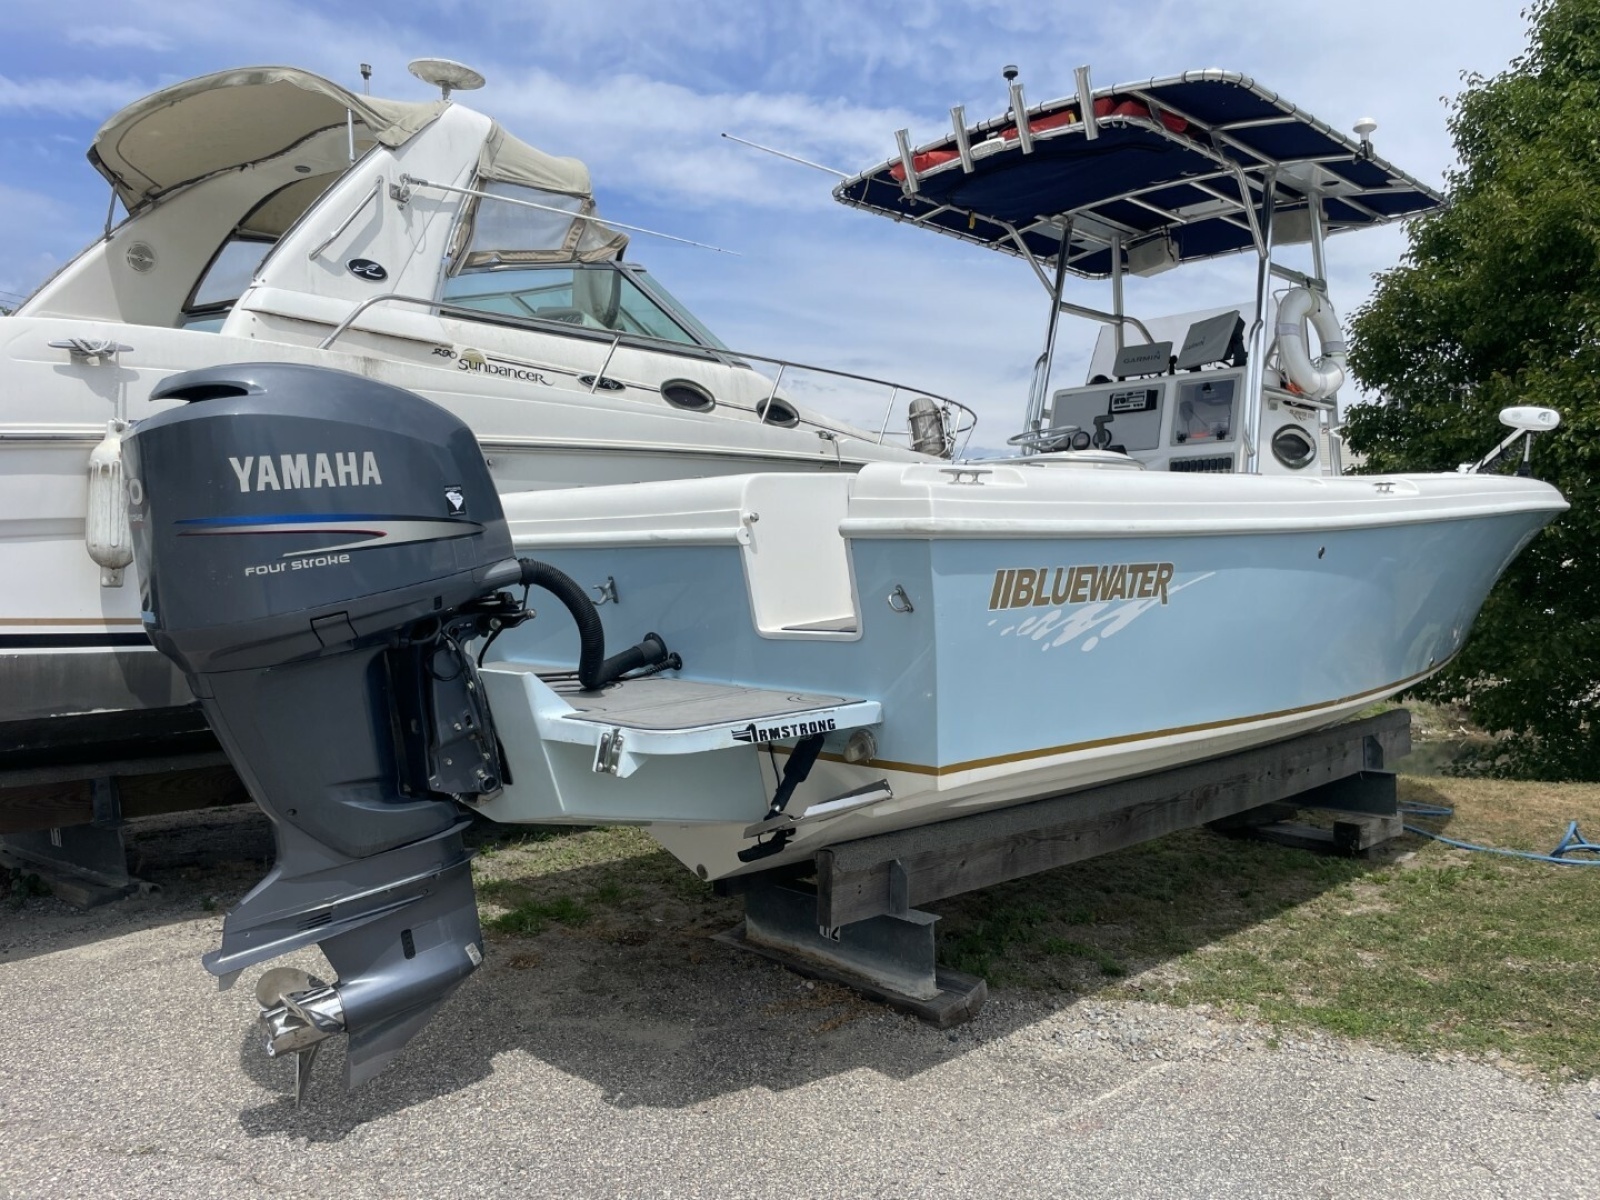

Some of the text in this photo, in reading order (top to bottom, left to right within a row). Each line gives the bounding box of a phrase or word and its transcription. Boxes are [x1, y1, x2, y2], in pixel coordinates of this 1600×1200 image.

[432, 347, 458, 359] 290
[1123, 354, 1161, 364] GARMIN
[228, 451, 383, 493] YAMAHA
[732, 718, 836, 742] ARMSTRONG
